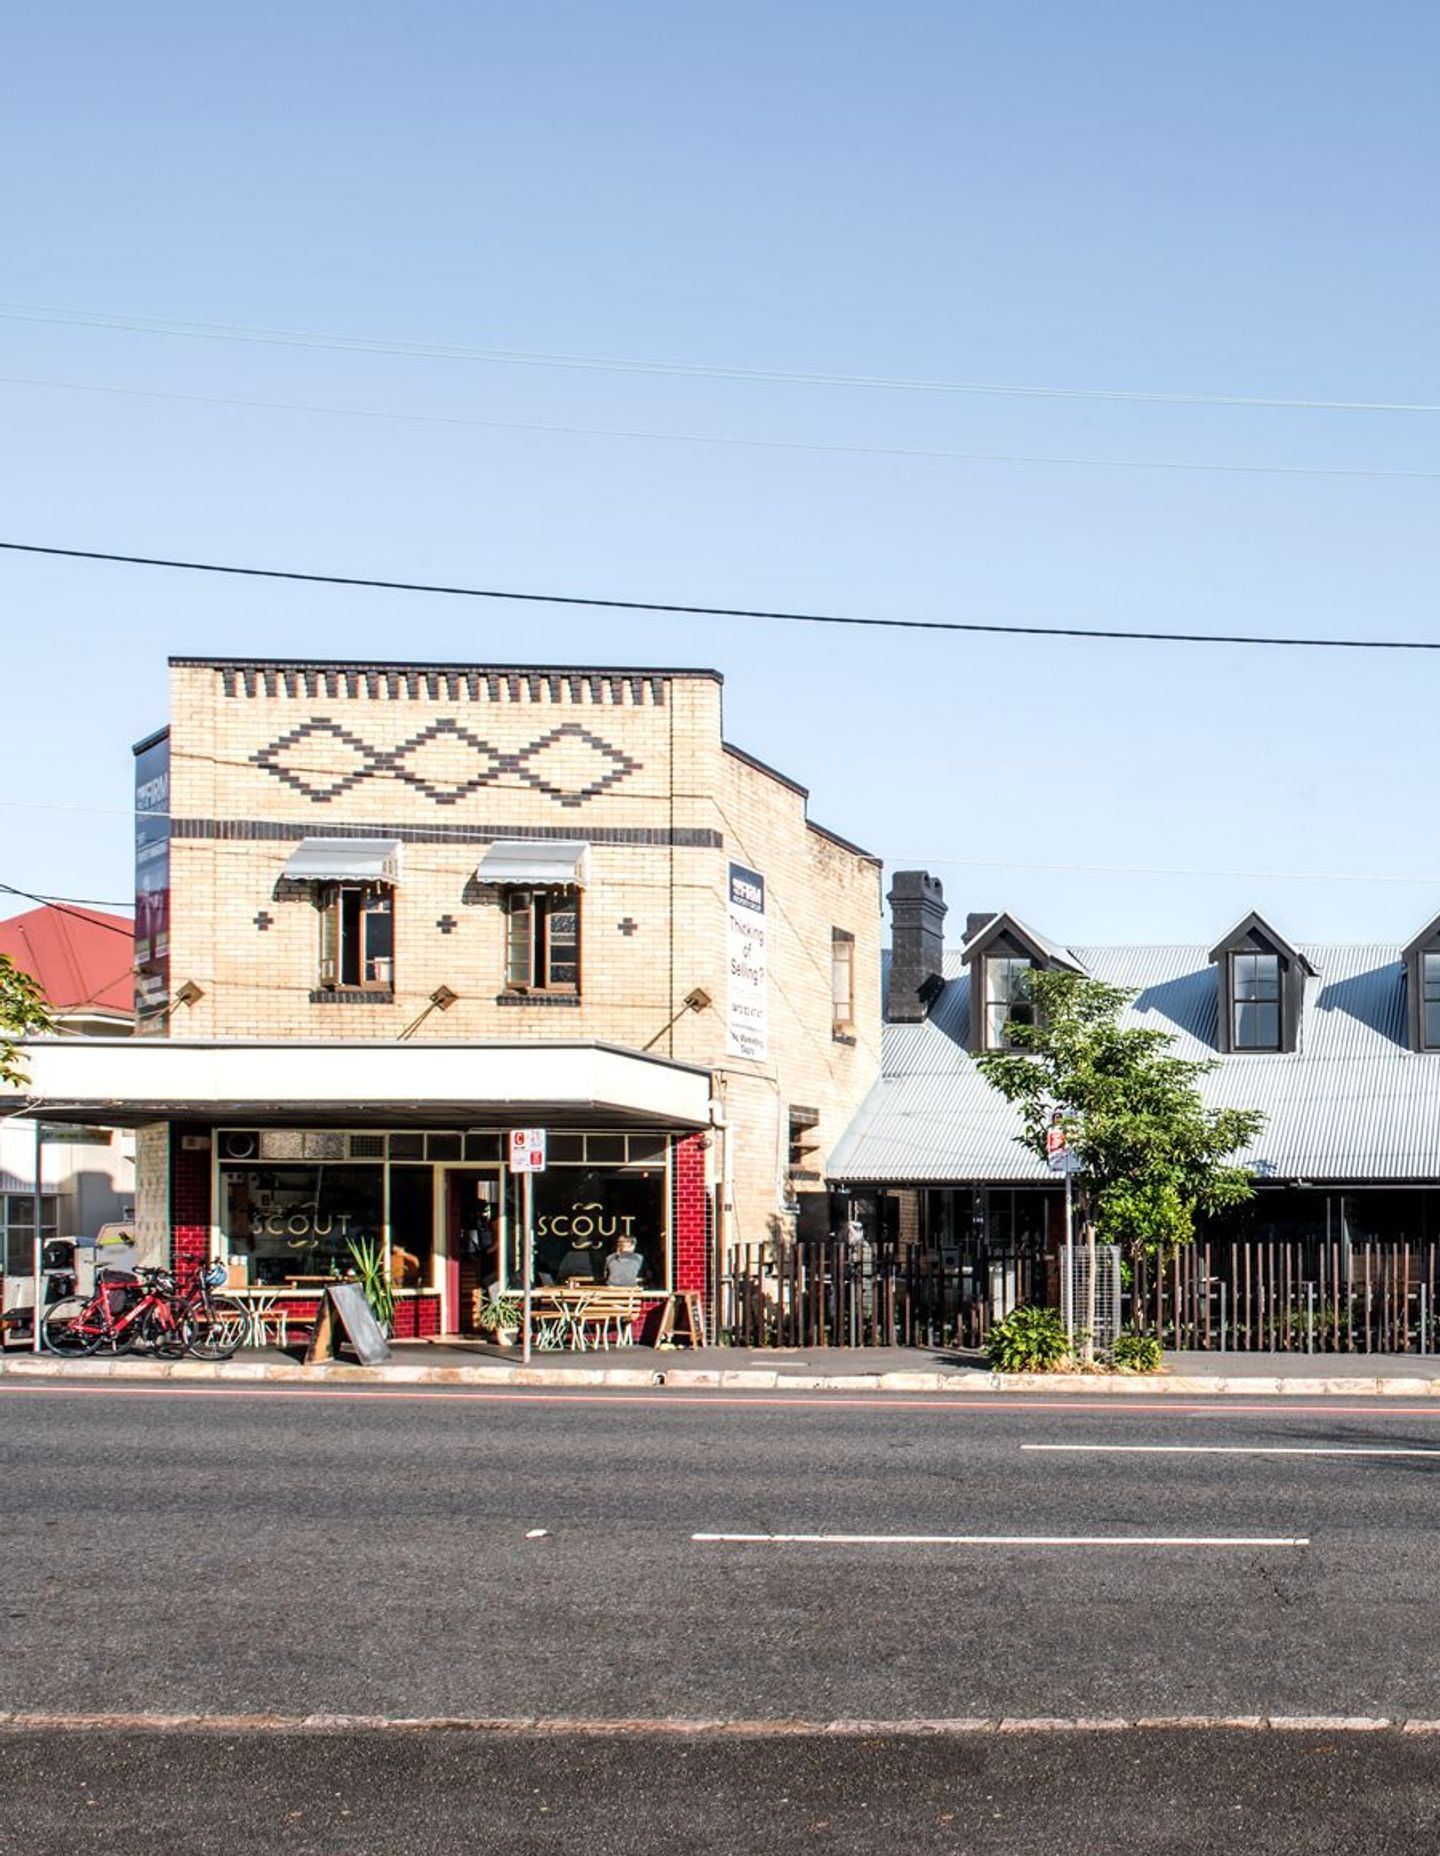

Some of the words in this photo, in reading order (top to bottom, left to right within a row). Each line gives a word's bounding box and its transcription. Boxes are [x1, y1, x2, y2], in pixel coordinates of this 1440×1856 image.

[730, 914, 764, 947] Thinking
[743, 942, 752, 959] of
[731, 958, 764, 986] Selling?
[252, 1214, 352, 1236] SCOUT
[537, 1216, 636, 1237] SCOUT
